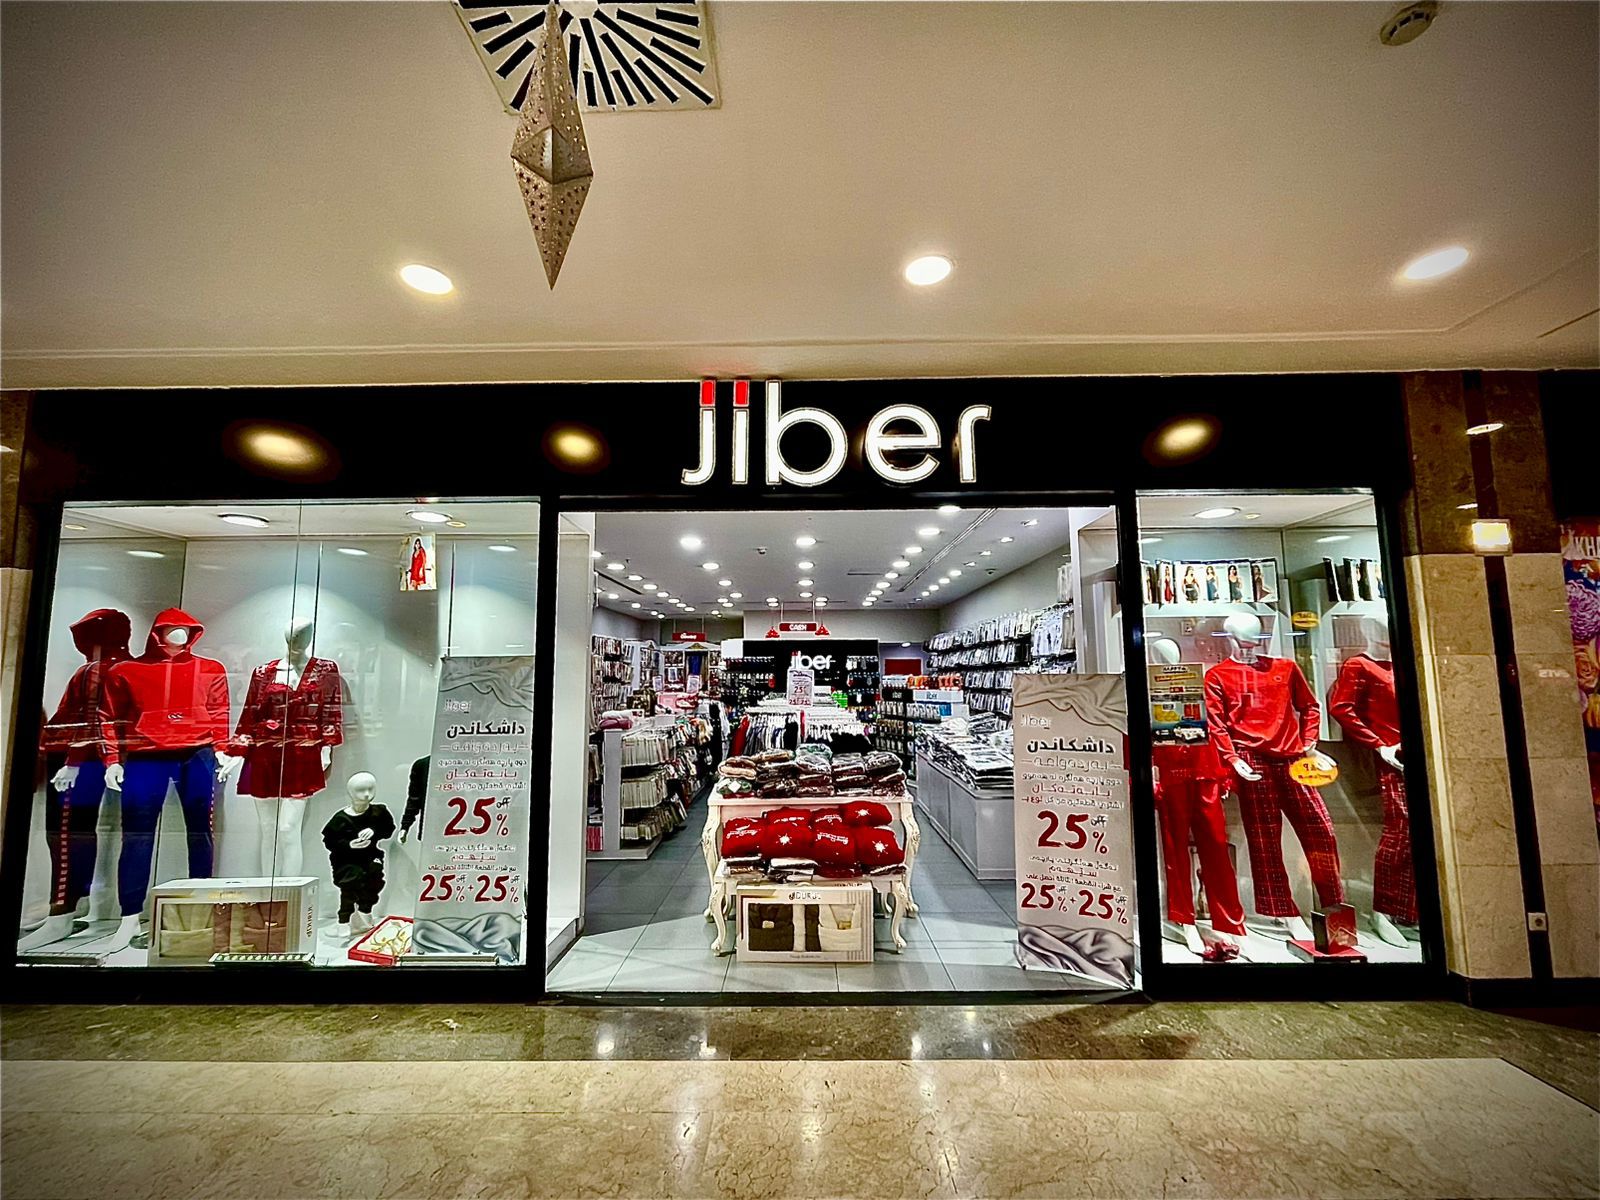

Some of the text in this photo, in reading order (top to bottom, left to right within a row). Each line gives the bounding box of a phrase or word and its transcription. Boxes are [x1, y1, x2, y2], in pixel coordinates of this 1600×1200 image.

[681, 380, 992, 487] jiber
[446, 719, 526, 739] داشکاندن
[1026, 737, 1115, 754] داشکاندن
[444, 797, 496, 836] 25
[1037, 810, 1089, 849] 25
[419, 874, 456, 901] 25
[475, 874, 510, 902] 25
[1021, 882, 1055, 909] 25
[1078, 889, 1114, 919] 25
